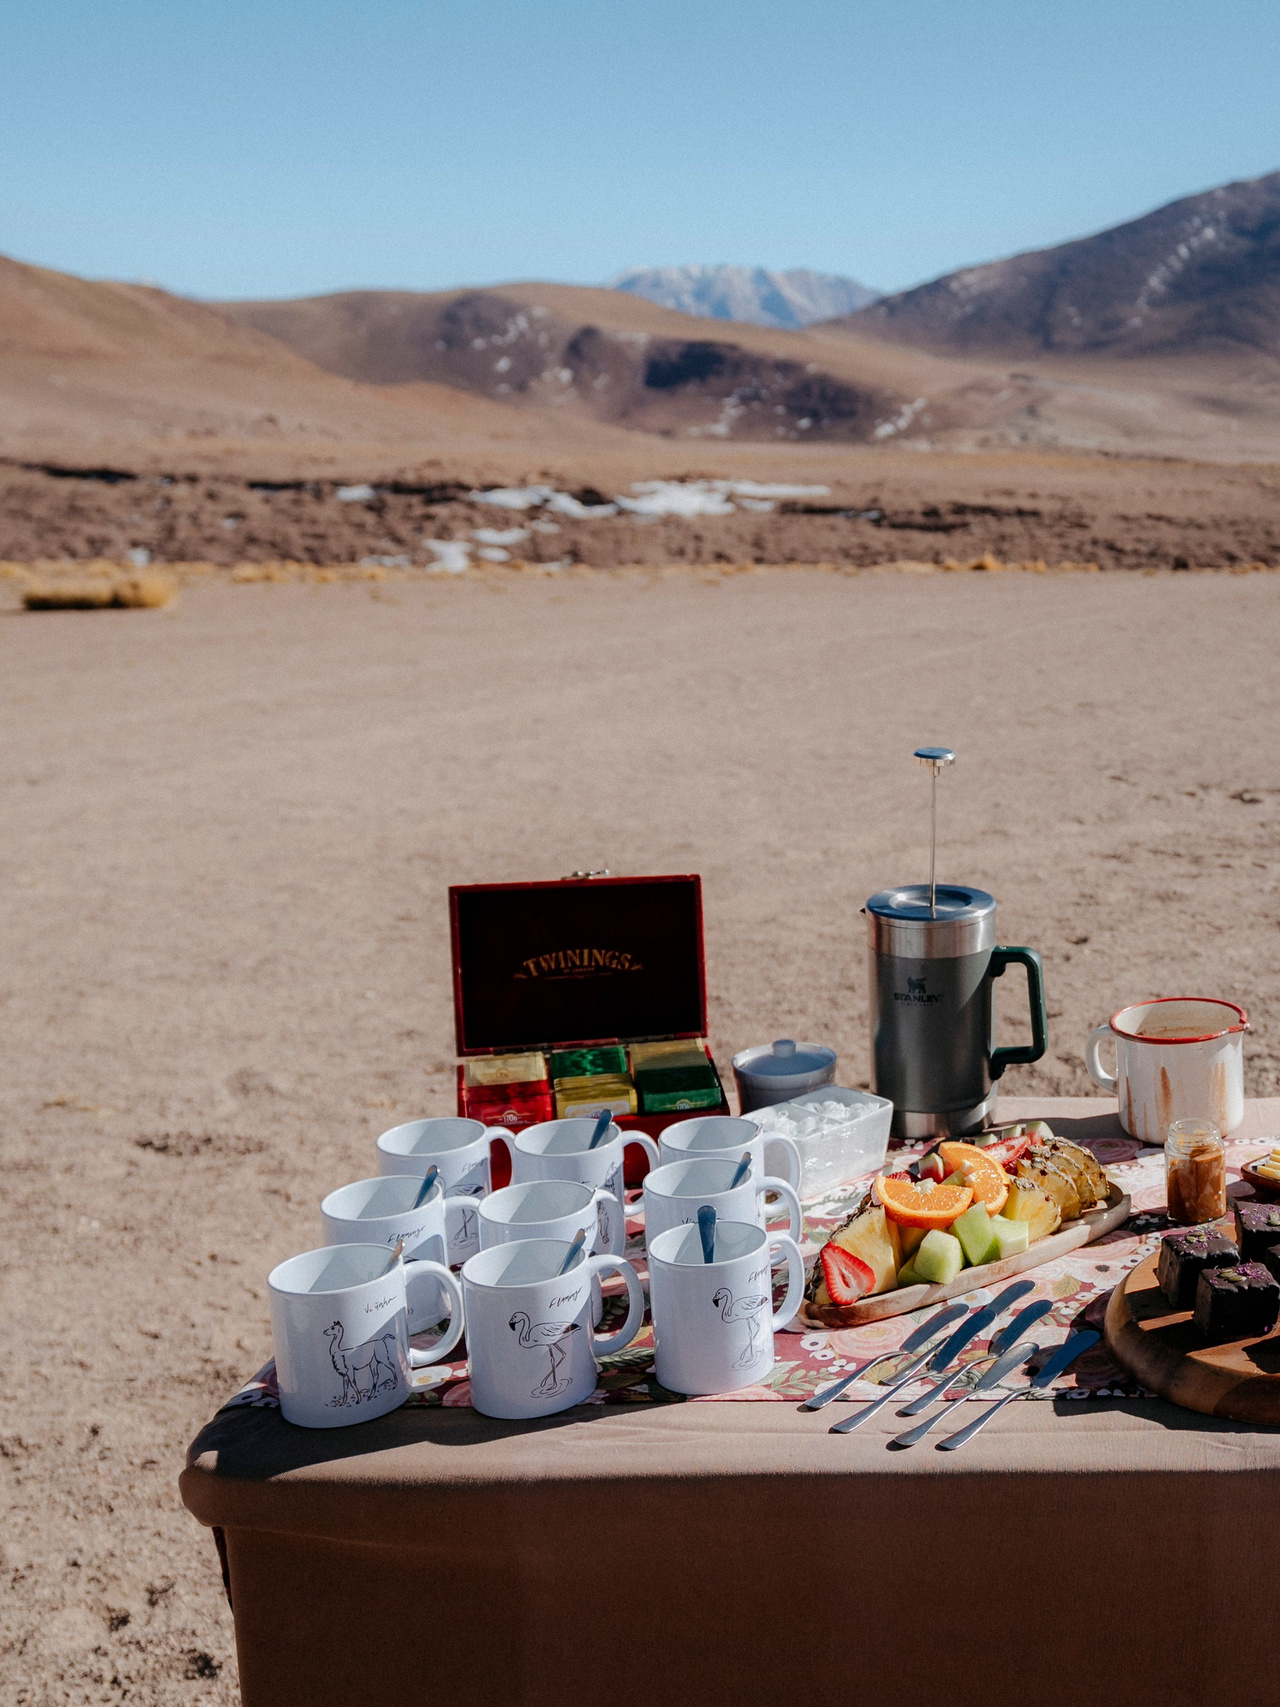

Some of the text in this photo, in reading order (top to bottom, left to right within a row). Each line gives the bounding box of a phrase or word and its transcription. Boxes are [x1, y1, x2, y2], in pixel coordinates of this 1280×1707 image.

[523, 948, 632, 976] TWININGS
[893, 993, 942, 1003] STANLEY
[503, 1113, 518, 1123] 1706
